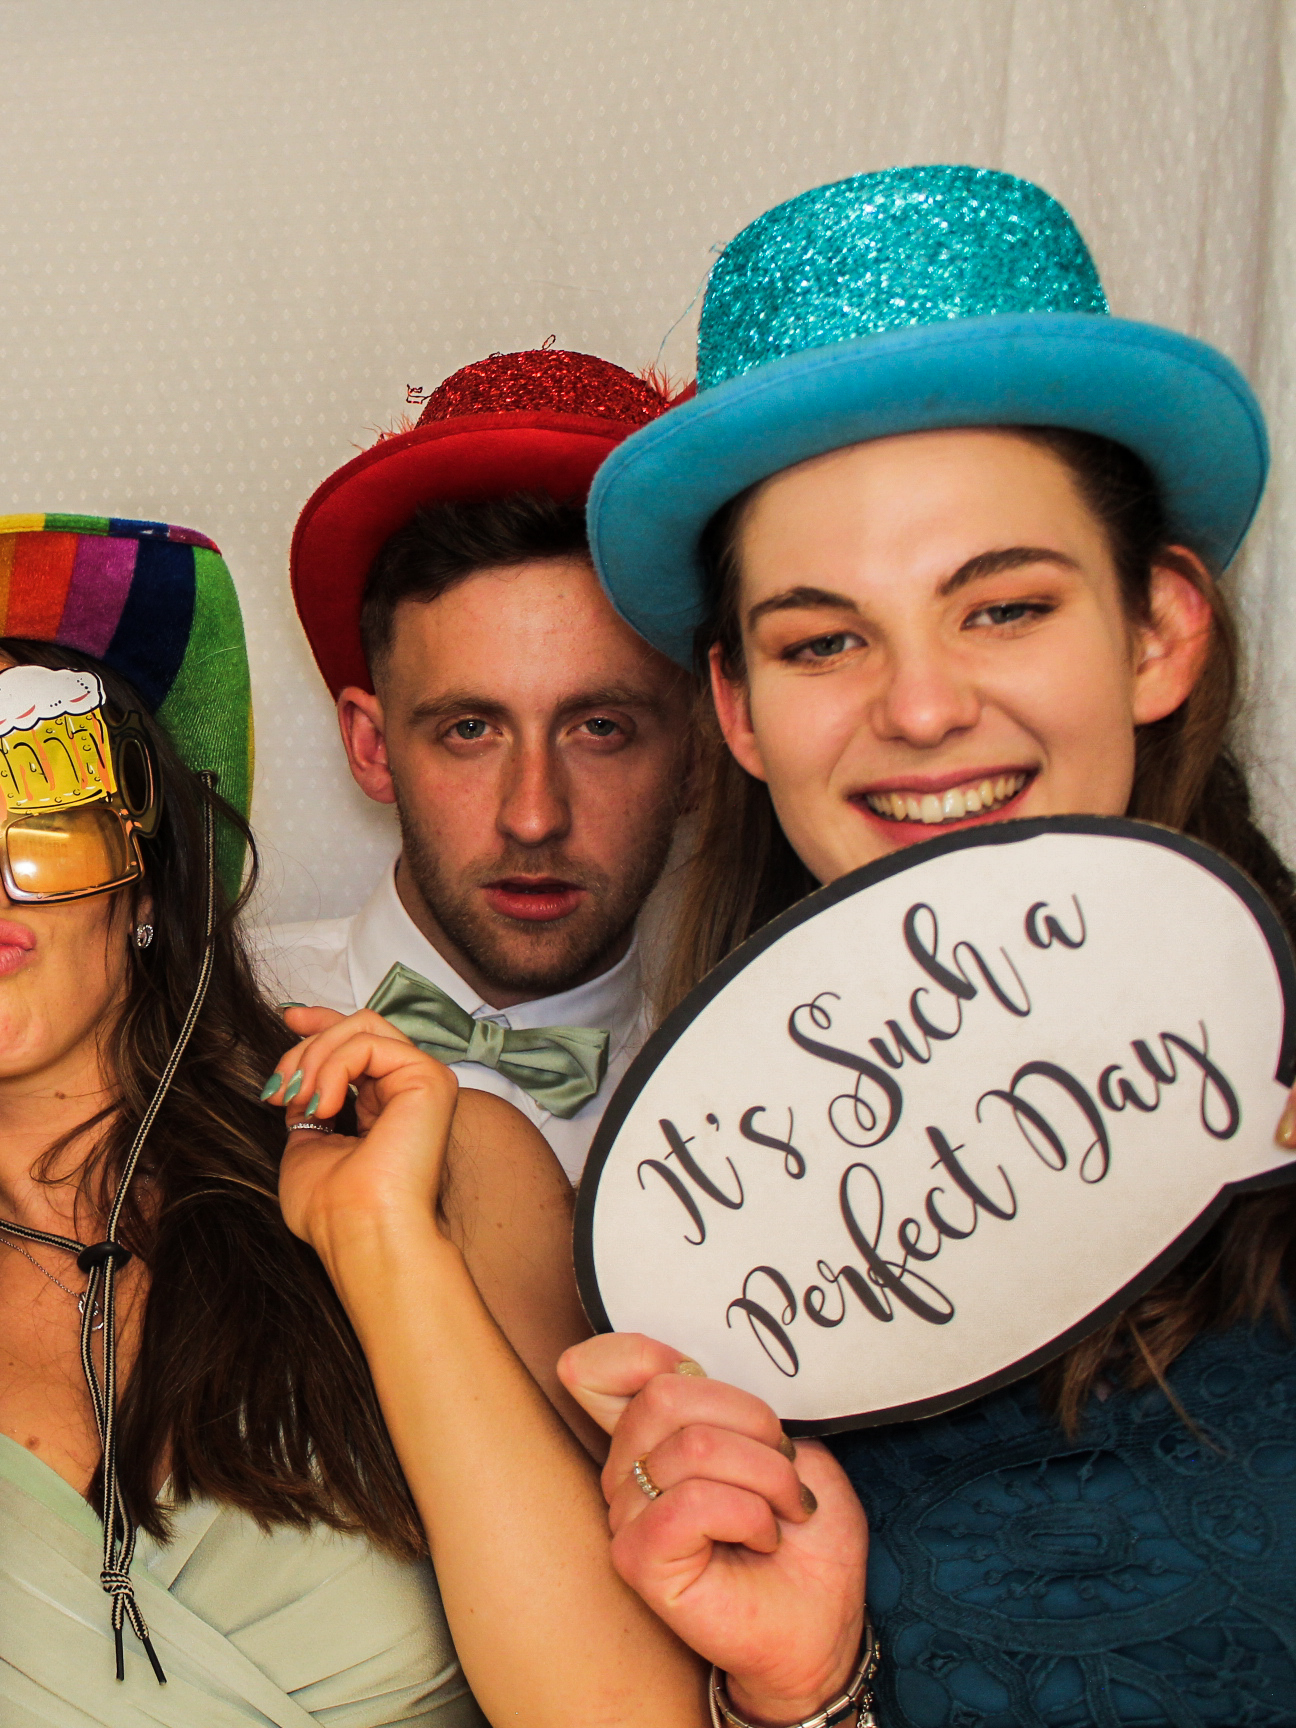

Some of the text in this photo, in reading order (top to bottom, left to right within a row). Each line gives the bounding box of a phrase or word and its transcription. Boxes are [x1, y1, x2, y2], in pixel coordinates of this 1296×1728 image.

[637, 893, 1086, 1246] It's Such a
[726, 1020, 1240, 1378] Perfect Day
